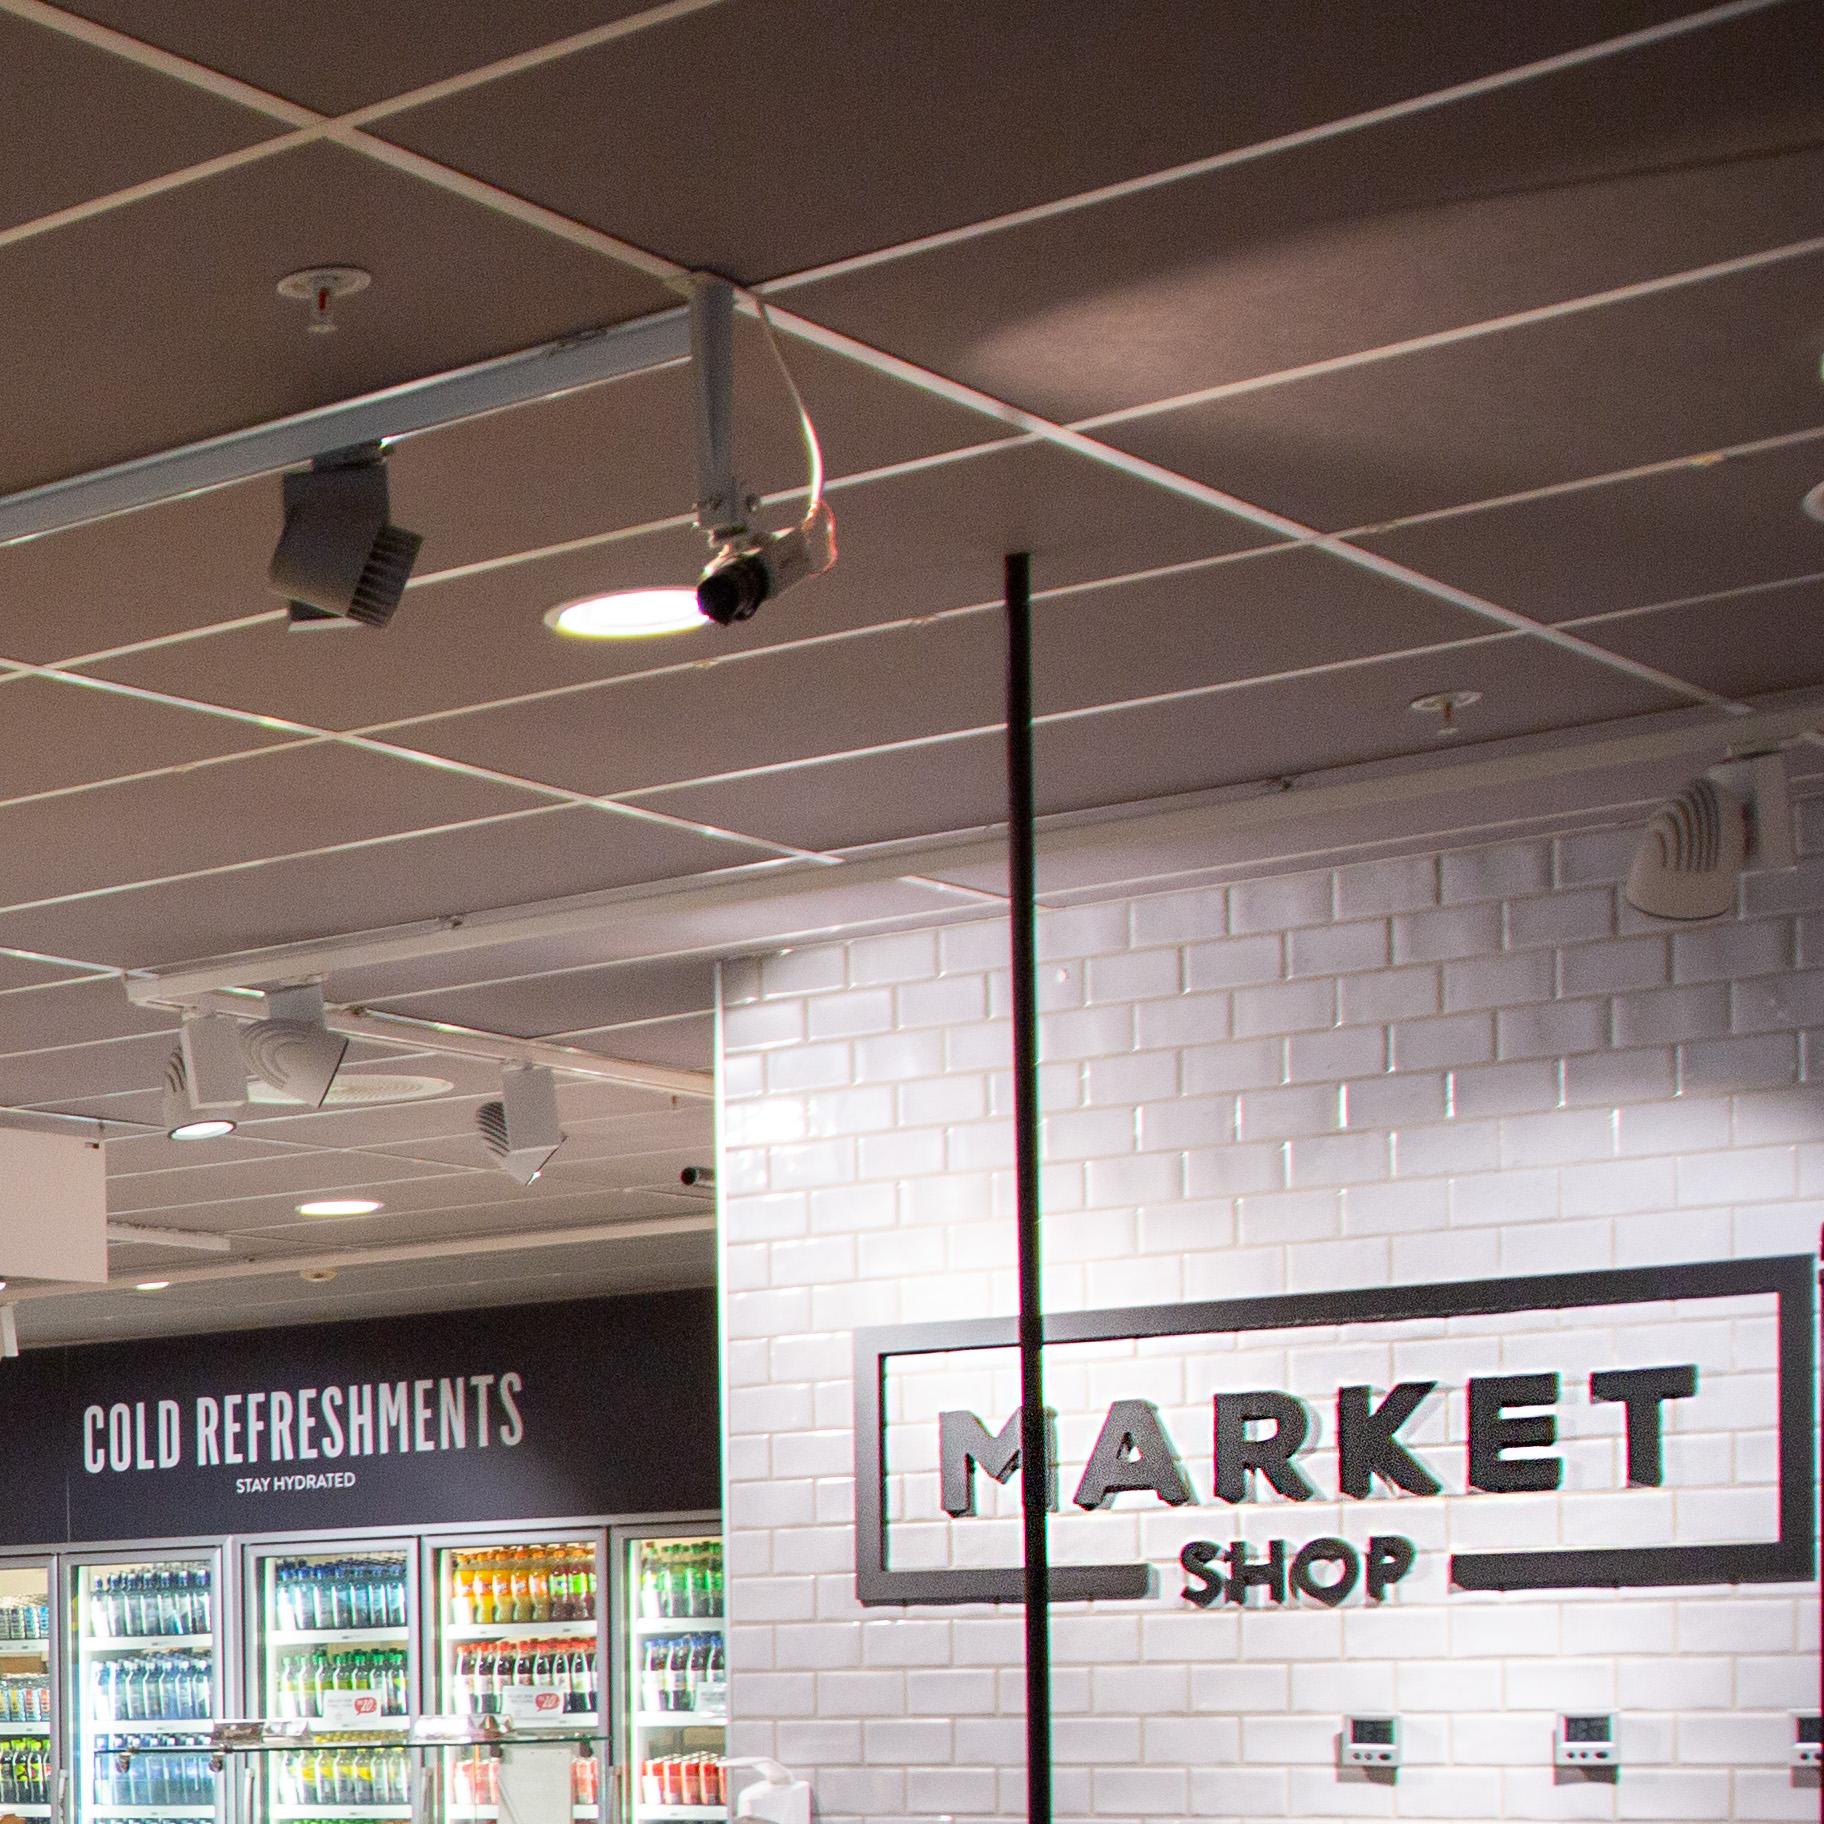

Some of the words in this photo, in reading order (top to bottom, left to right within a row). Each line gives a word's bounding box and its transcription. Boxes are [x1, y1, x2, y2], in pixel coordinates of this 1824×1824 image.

[83, 1399, 181, 1474] COLD
[196, 1371, 524, 1467] REFRESHMENTS
[938, 1365, 1699, 1517] MARKET
[235, 1476, 270, 1494] STAY
[273, 1472, 356, 1492] HYDRATED
[1178, 1535, 1422, 1607] SHOP
